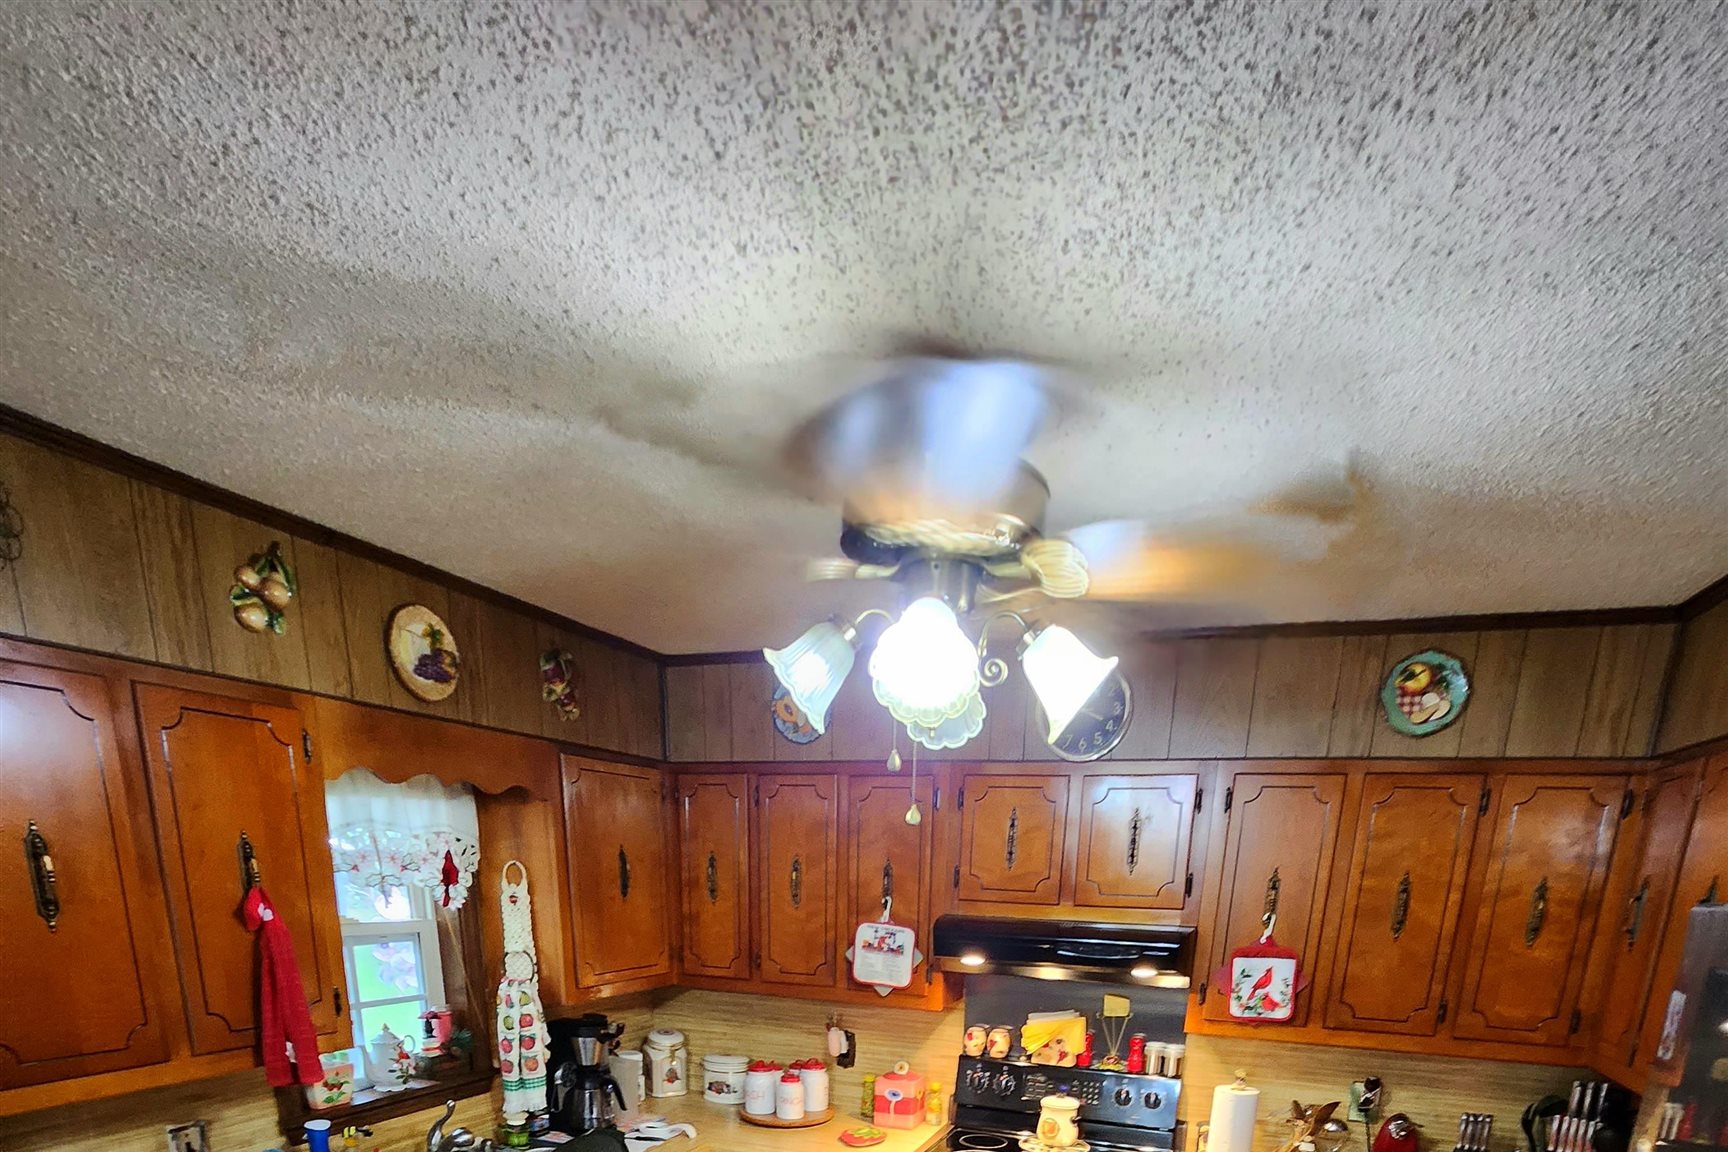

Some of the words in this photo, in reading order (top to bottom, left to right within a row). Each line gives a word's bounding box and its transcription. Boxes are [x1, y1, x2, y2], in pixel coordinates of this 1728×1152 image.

[1112, 702, 1121, 716] 3
[1105, 719, 1114, 732] 4
[1062, 734, 1073, 750] 7
[1078, 737, 1087, 753] 6
[1093, 731, 1102, 745] 5
